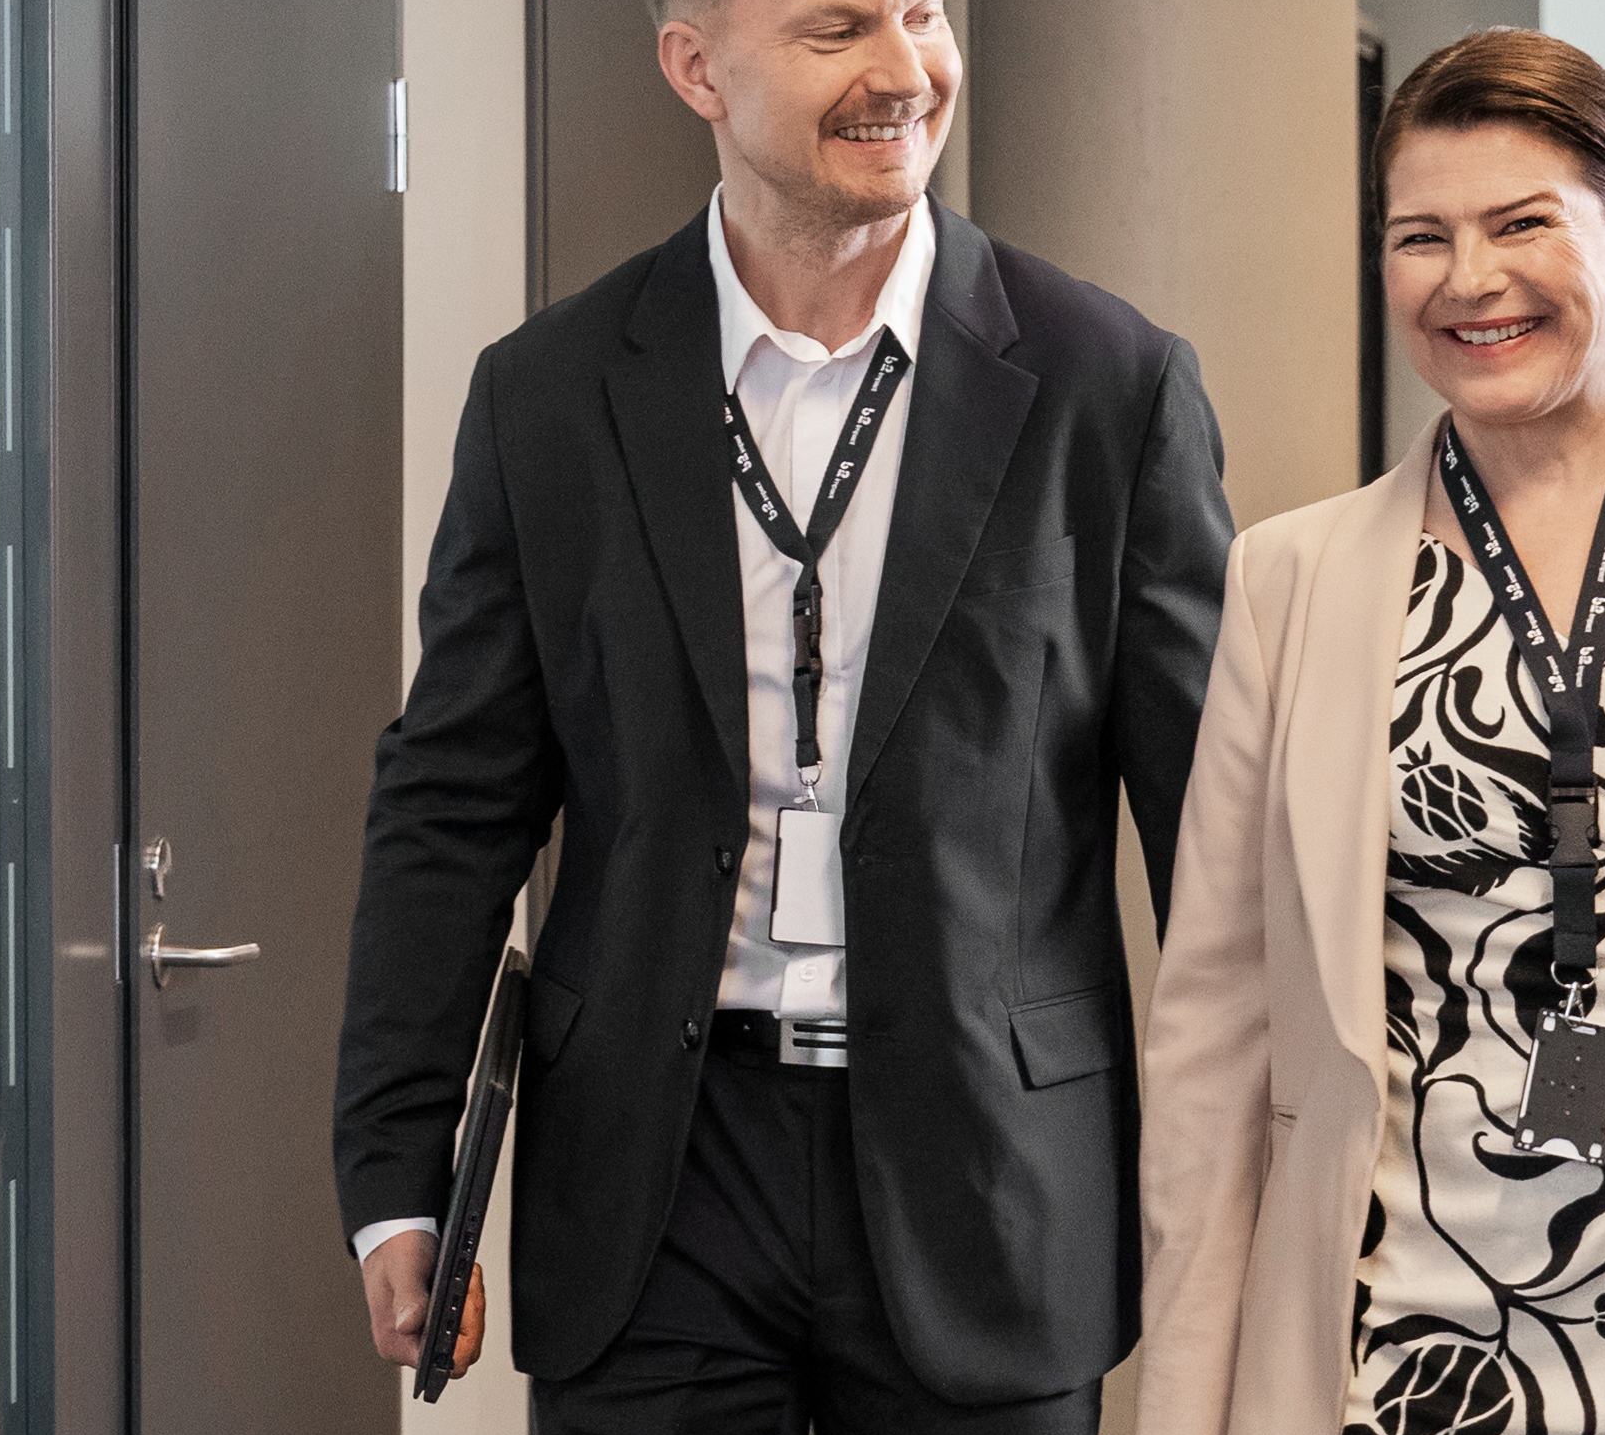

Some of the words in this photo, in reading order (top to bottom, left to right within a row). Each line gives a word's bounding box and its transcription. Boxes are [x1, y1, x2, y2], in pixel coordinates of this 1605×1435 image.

[881, 356, 898, 373] b2
[857, 408, 875, 426] b2
[737, 453, 752, 472] b2
[836, 461, 854, 478] b2
[761, 501, 778, 521] b2
